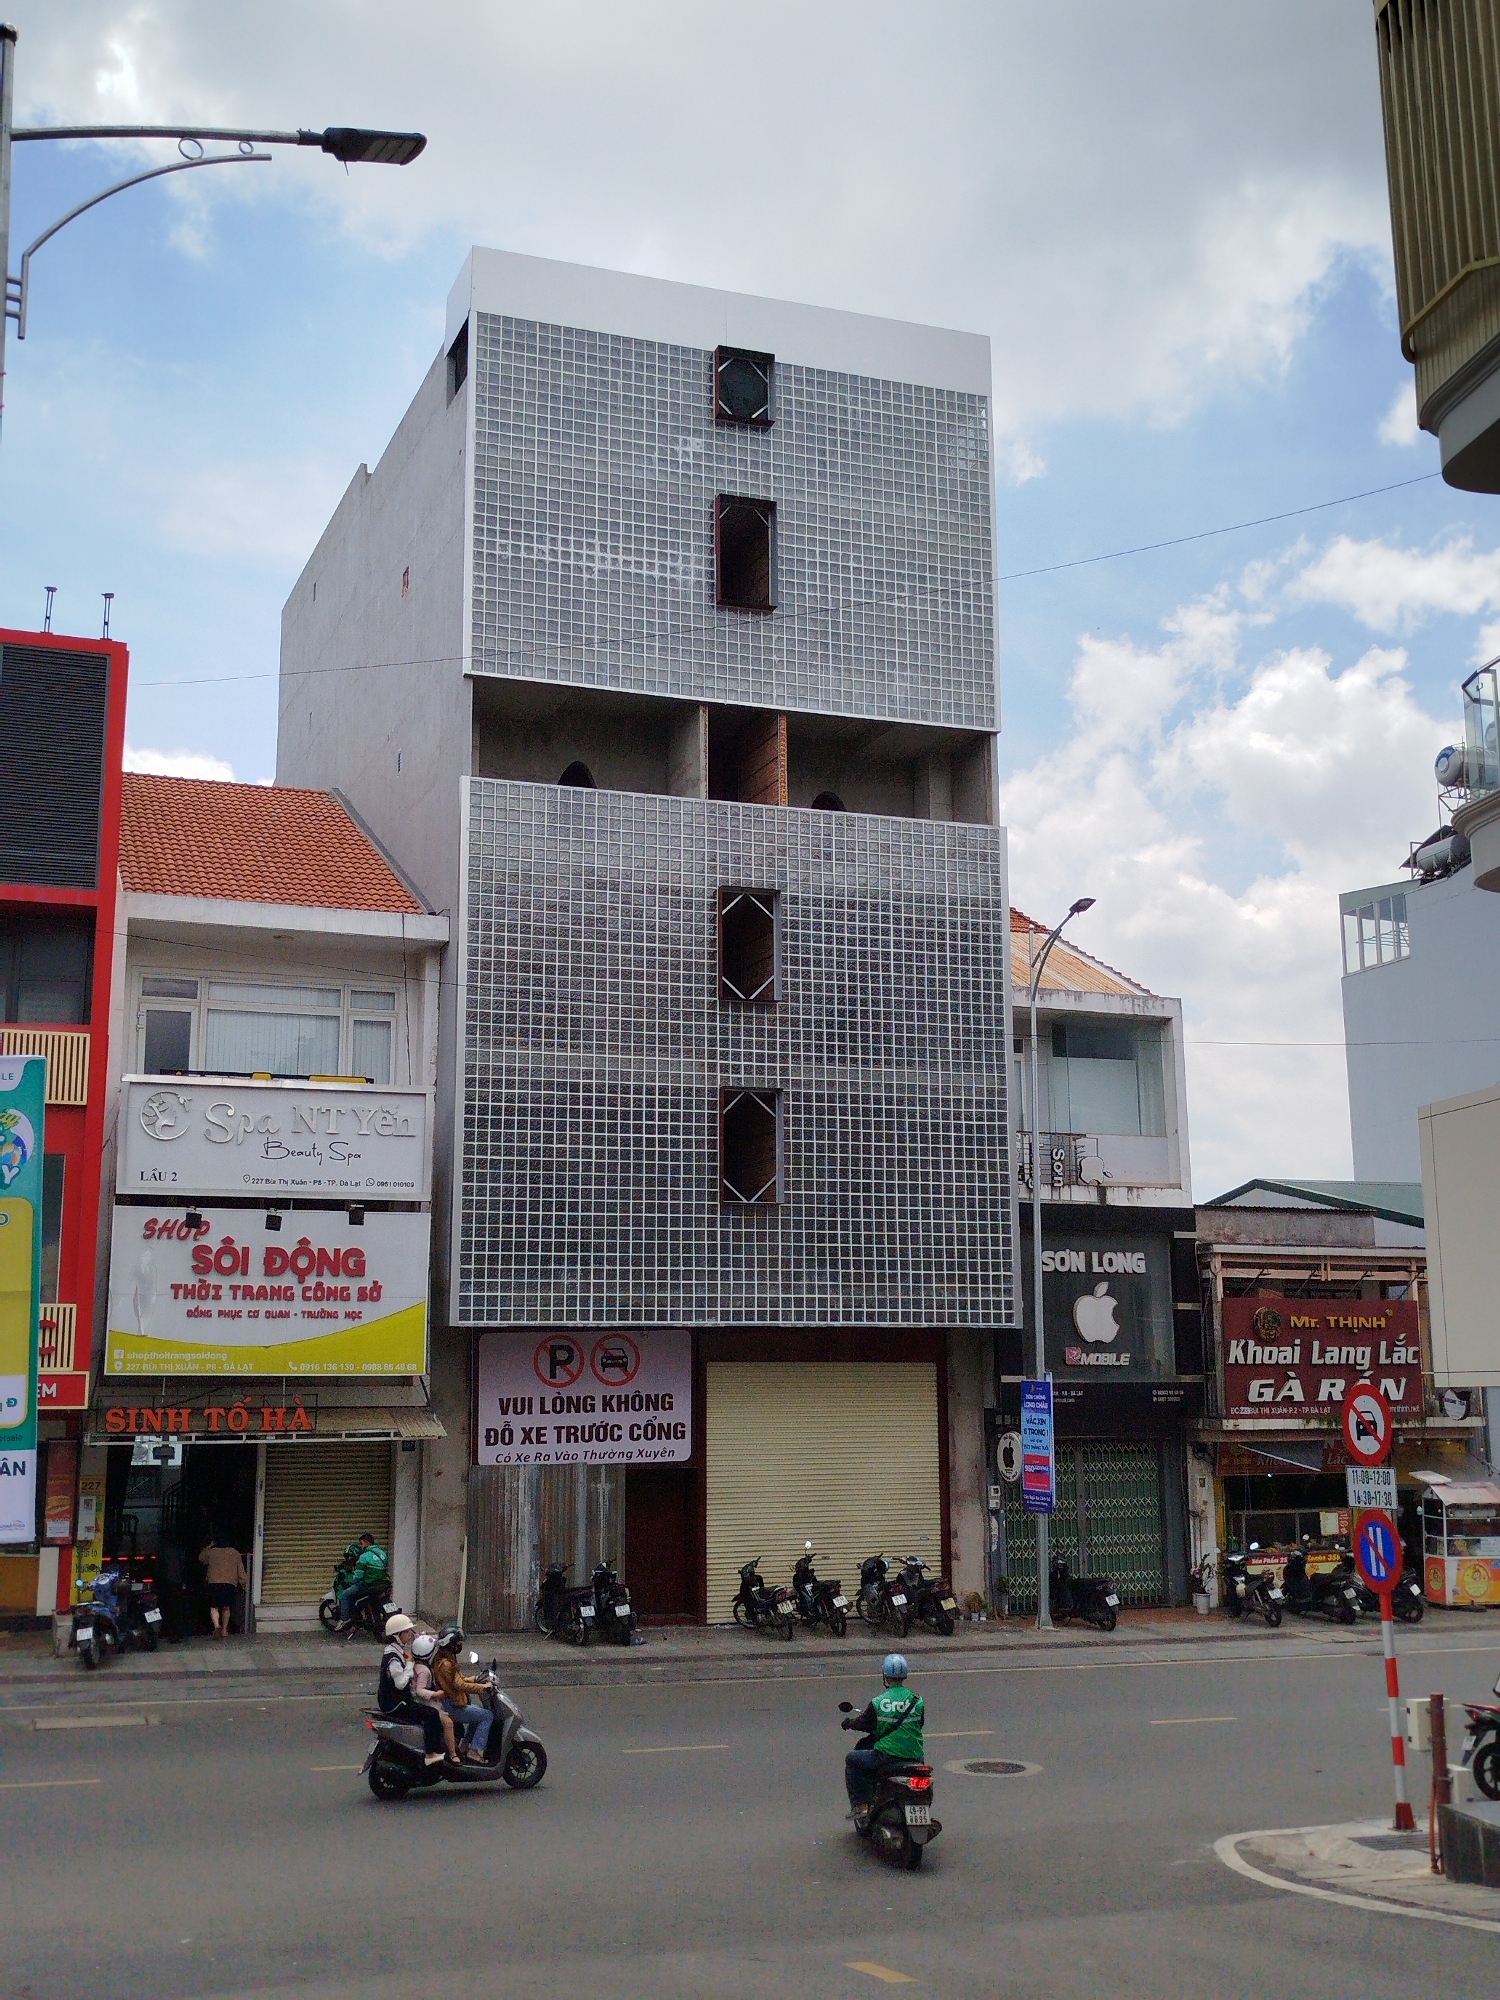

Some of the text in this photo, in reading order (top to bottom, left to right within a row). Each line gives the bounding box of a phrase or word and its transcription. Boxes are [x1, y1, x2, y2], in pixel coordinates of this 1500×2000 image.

[203, 1102, 280, 1145] Spa
[292, 1105, 346, 1135] NT
[260, 1137, 362, 1167] Beauty Spa
[140, 1168, 178, 1182] LẦU 2
[143, 1217, 211, 1241] SHOP
[191, 1235, 366, 1284] SÔI ĐỘNG
[1041, 1248, 1147, 1274] SƠN LONG
[171, 1278, 383, 1302] THỜI TRANG CÔNG SỞ
[1290, 1315, 1386, 1333] Mr. THỊNH
[1080, 1352, 1131, 1366] MOBILE
[1227, 1332, 1420, 1370] Khoai Lang Lắc
[1248, 1371, 1305, 1403] GÀ
[105, 1395, 313, 1433] SINH TỐ HÀ
[498, 1389, 674, 1416] VUI LÒNG KHÔNG
[484, 1415, 686, 1447] ĐỖ XE TRƯỚC CỔNG
[495, 1446, 675, 1464] Có Xe Ra Vào Thường Xuyên
